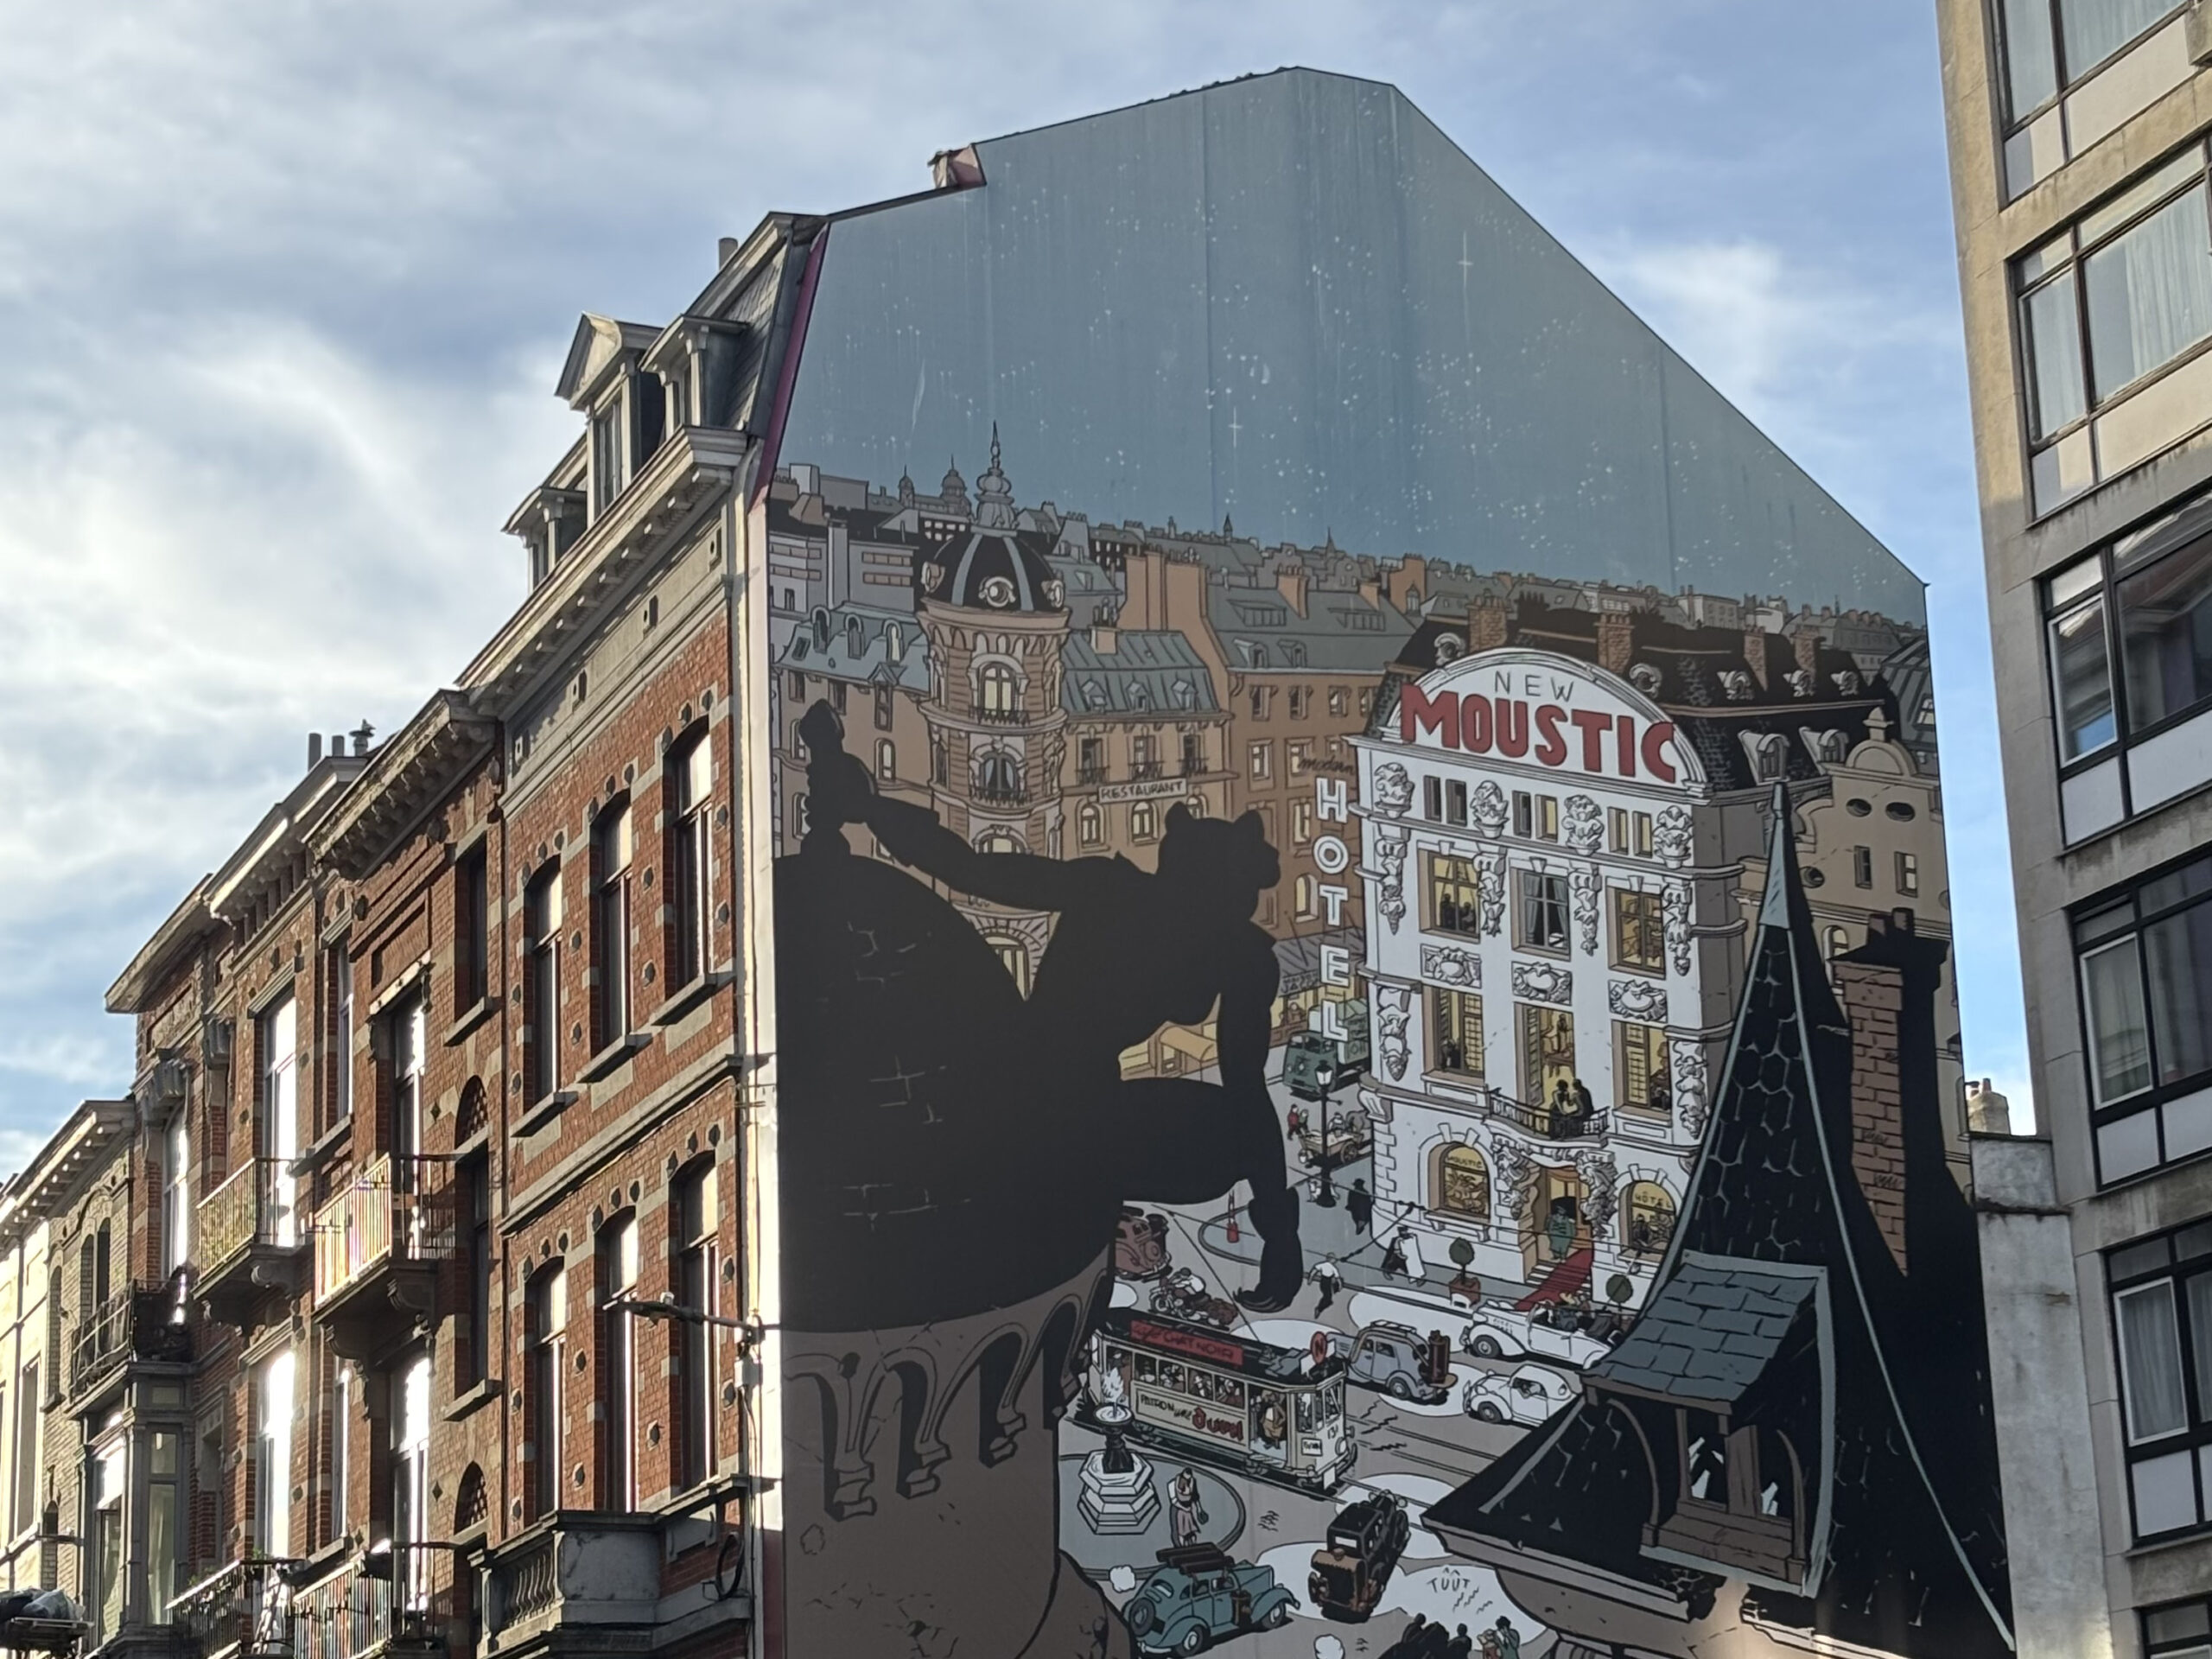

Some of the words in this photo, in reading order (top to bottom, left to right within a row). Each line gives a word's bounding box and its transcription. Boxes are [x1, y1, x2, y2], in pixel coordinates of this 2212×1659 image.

[1494, 671, 1575, 702] NEW
[1400, 683, 1677, 784] MOUSTIC
[1100, 780, 1184, 800] RESTAURANT
[1313, 775, 1350, 1042] HOTEL
